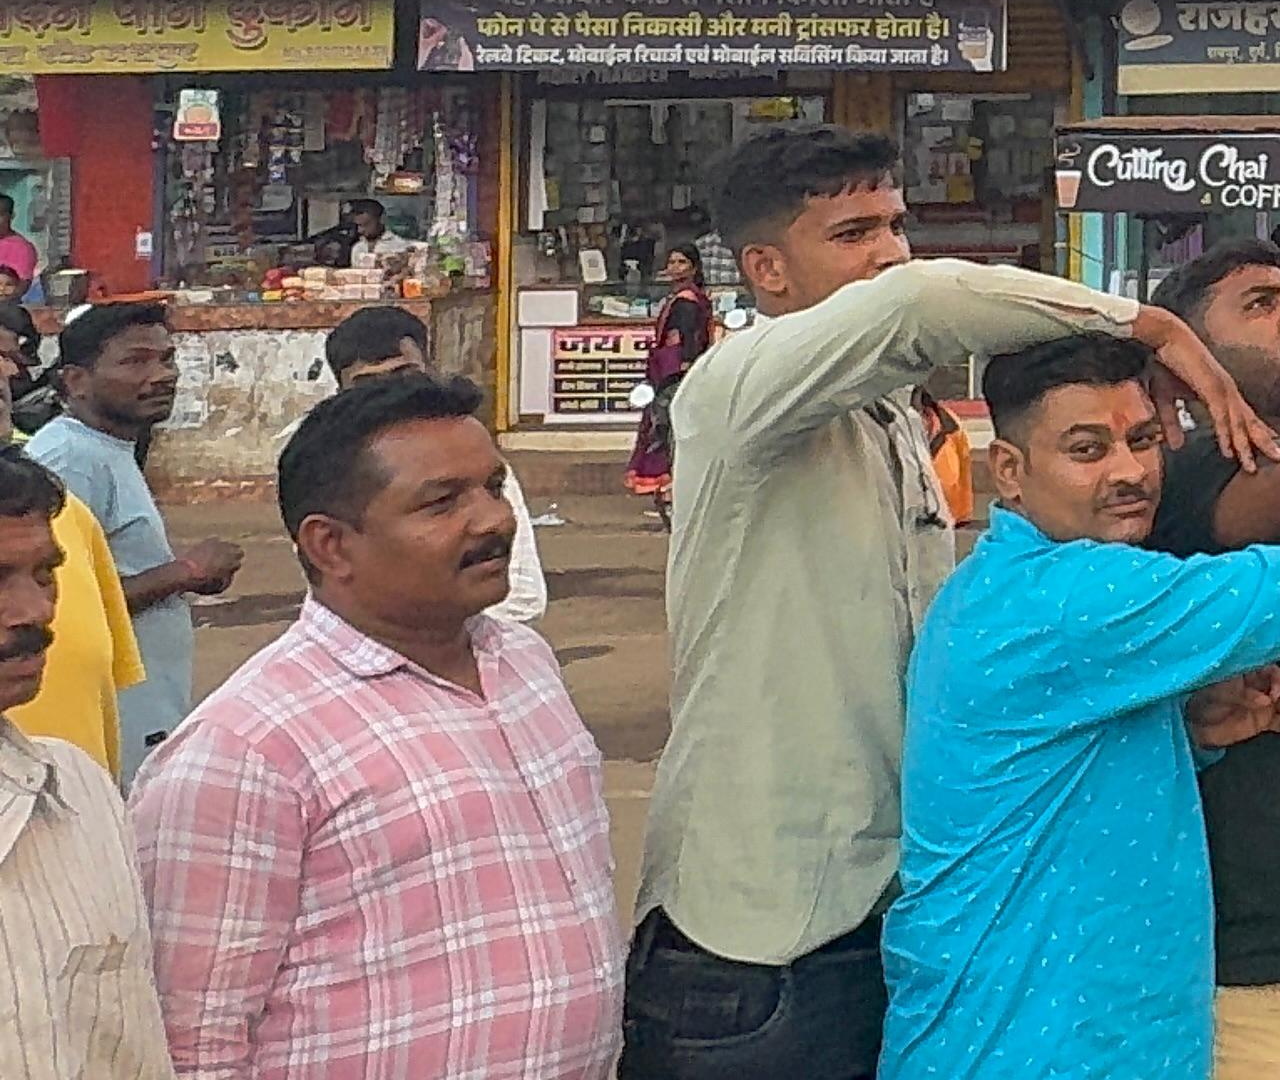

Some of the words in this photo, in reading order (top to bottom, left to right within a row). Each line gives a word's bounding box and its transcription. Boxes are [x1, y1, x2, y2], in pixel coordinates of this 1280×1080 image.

[477, 11, 526, 38] फोन
[528, 11, 546, 38] पे
[550, 11, 570, 38] से
[575, 9, 617, 38] पैसा
[622, 11, 703, 38] निकासी
[706, 9, 747, 38] और
[750, 11, 793, 38] मनी
[796, 12, 872, 42] ट्रांसफर
[875, 11, 923, 40] होता
[475, 43, 513, 64] रेलवे
[685, 43, 710, 64] एवं
[846, 44, 888, 64] किया
[889, 45, 927, 64] जाता
[1087, 143, 1196, 192] Cutting
[1199, 142, 1269, 188] Chai
